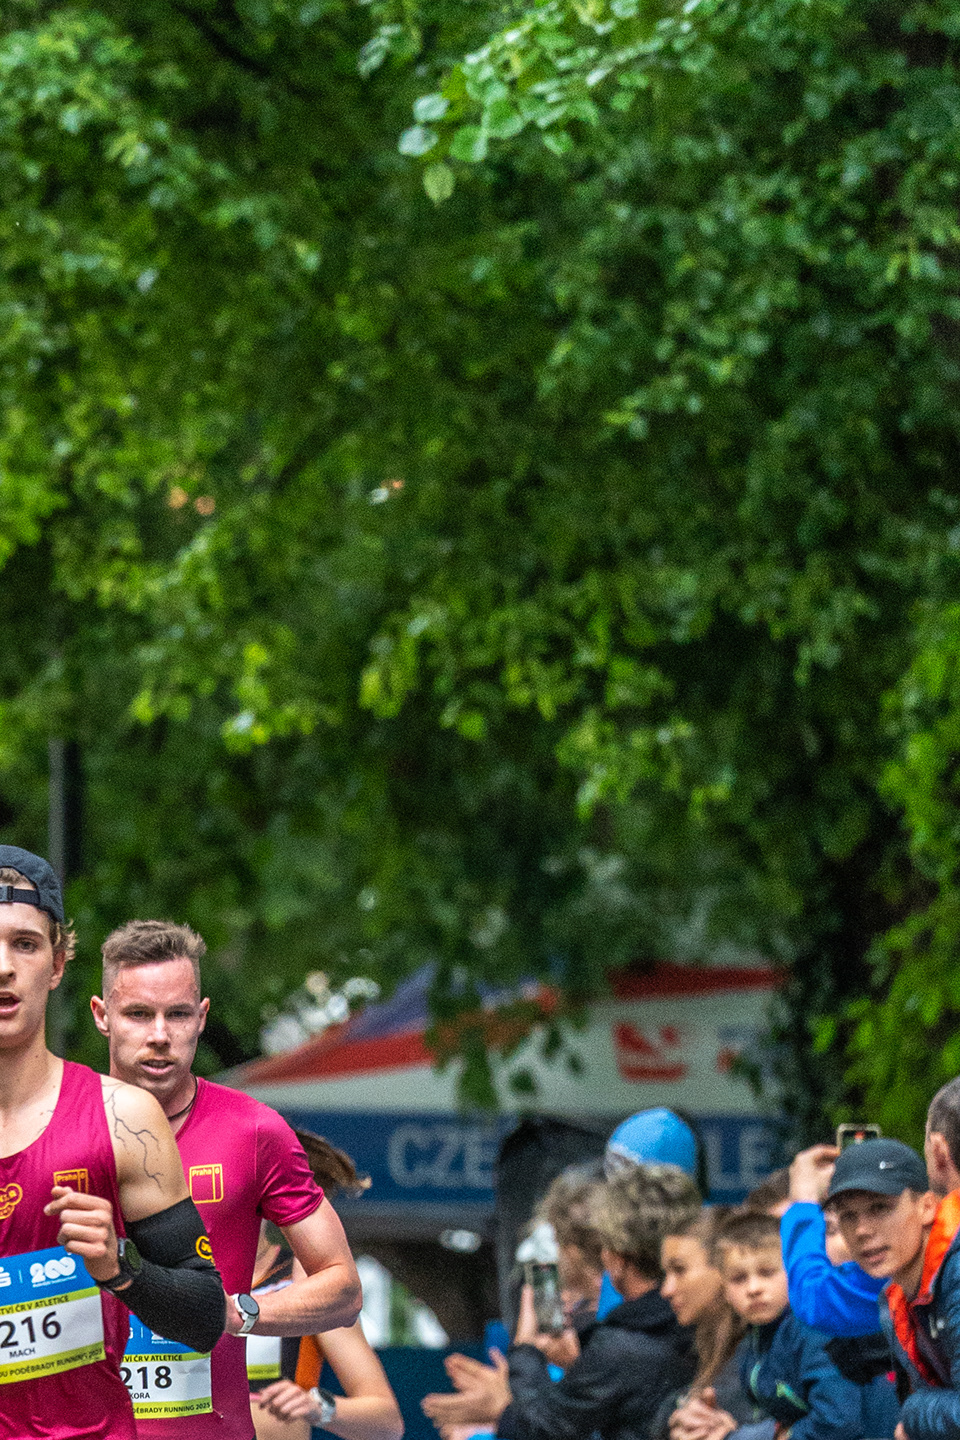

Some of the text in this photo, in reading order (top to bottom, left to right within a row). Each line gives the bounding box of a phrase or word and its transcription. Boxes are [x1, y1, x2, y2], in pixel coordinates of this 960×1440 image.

[15, 1304, 26, 1312] ČR
[35, 1295, 69, 1308] ATLETICE
[9, 1347, 35, 1359] MACH
[9, 1362, 55, 1376] PODĚBRADY
[164, 1405, 195, 1413] RUNNING
